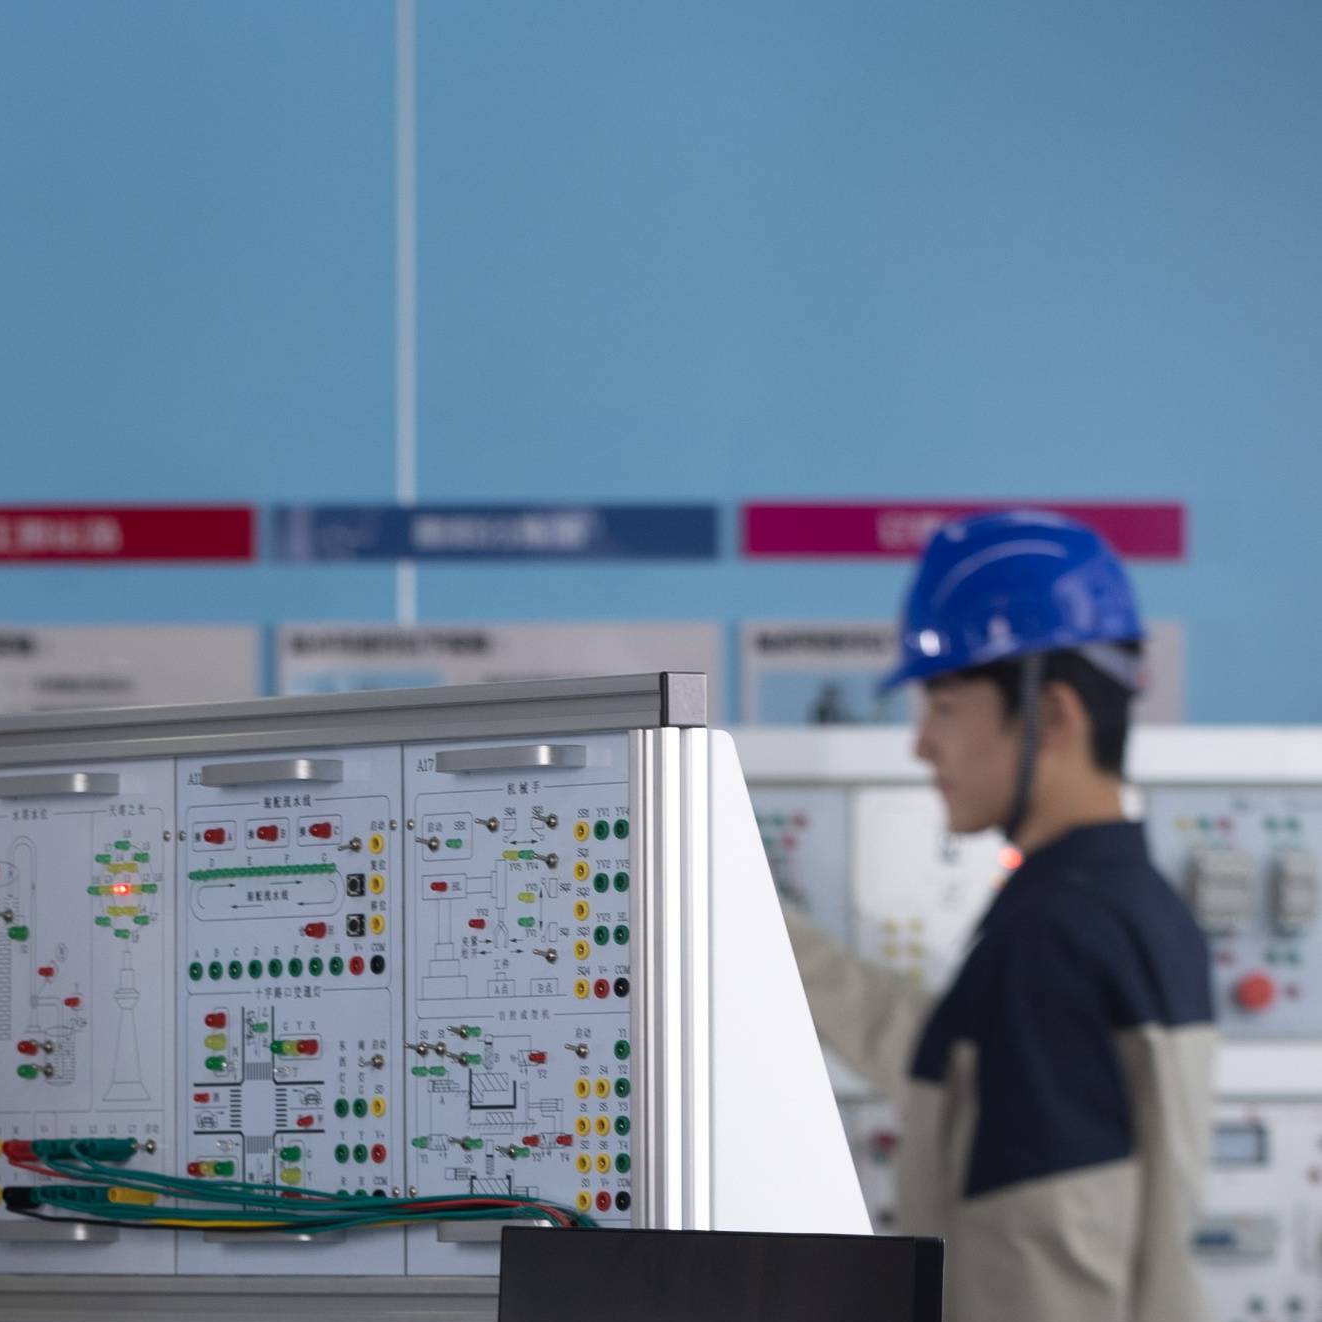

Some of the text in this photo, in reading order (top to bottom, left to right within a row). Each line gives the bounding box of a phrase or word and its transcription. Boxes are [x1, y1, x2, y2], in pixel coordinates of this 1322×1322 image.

[415, 758, 435, 773] A17
[506, 779, 542, 796] 机械手
[263, 794, 312, 809] 装配流水线
[615, 806, 630, 817] YV4
[370, 821, 386, 832] 启动
[427, 822, 443, 833] 启动
[370, 860, 387, 871] 复位
[508, 862, 539, 872] YV5 YV4
[596, 859, 611, 870] YV2
[615, 859, 630, 870] YV5
[246, 890, 290, 902] 装配流水线
[476, 908, 490, 917] YV2
[353, 943, 364, 953] V+
[371, 943, 386, 953] COM
[493, 959, 510, 970] 工件
[576, 965, 630, 976] SQ4 V+ COM
[254, 984, 322, 999] 十字路口交通灯
[493, 982, 553, 995] A点 B点
[575, 1028, 592, 1039] 启动
[372, 1039, 387, 1050] 启动
[538, 1068, 547, 1079] Y2
[618, 1065, 629, 1075] Y2
[618, 1102, 629, 1112] Y3
[618, 1140, 629, 1150] Y4
[560, 1152, 571, 1163] Y4
[617, 1178, 631, 1188] COM
